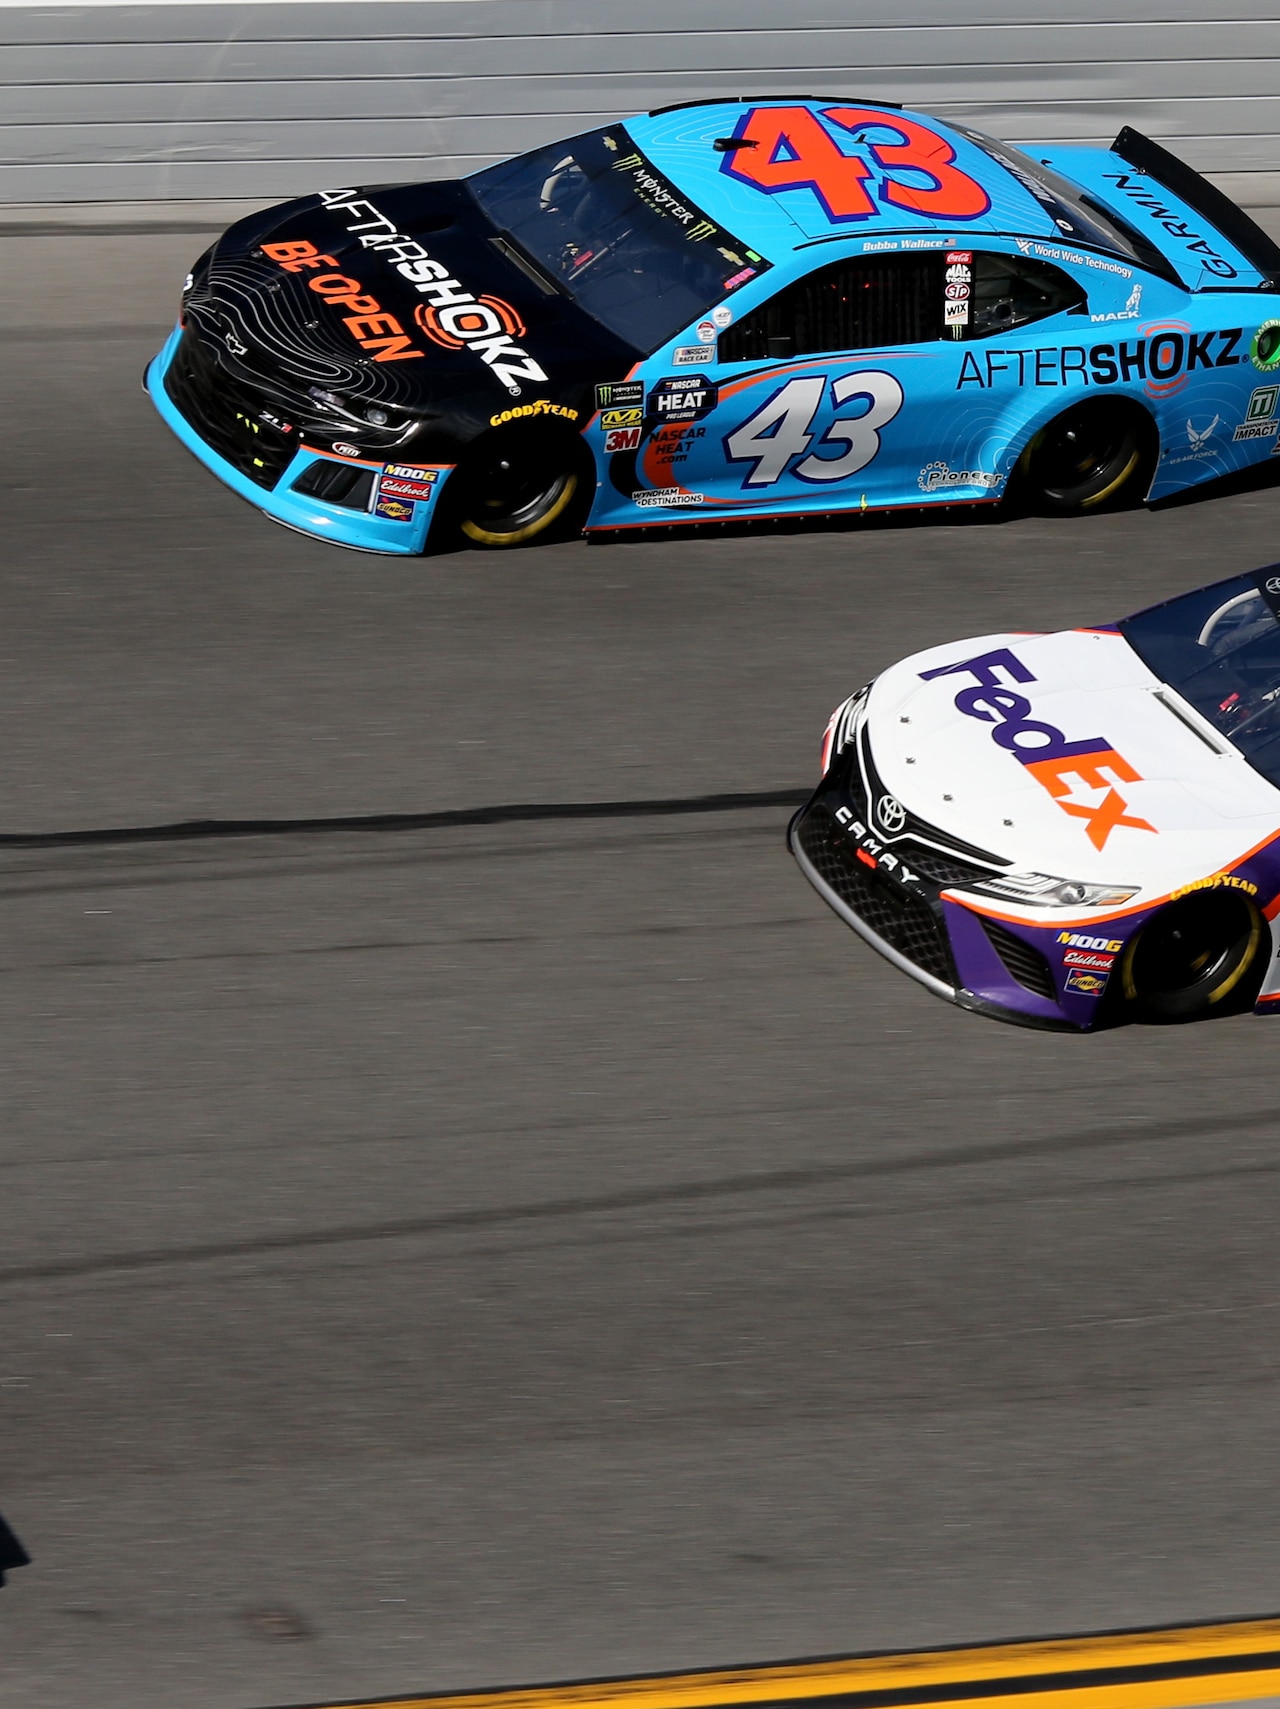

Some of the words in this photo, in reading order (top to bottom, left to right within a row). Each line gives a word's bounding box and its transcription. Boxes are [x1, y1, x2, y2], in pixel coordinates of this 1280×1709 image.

[721, 105, 991, 224] 43
[1101, 174, 1238, 279] GARMIN
[862, 242, 898, 252] Bubba
[900, 239, 943, 249] Wallace
[1034, 244, 1061, 260] World
[1062, 251, 1083, 265] Wide
[1084, 257, 1133, 279] Technology
[948, 284, 967, 298] STP
[260, 240, 339, 273] BE
[308, 273, 424, 363] OPEN
[946, 303, 966, 317] WIX
[1091, 311, 1139, 322] MACK
[956, 328, 1244, 390] AFTERSHOKZ
[671, 379, 701, 390] NASCAR
[658, 391, 706, 411] HEAT
[649, 427, 706, 443] NASCAR
[725, 369, 903, 490] 43
[1235, 426, 1276, 440] IMPACT
[606, 429, 641, 451] 3M
[656, 441, 695, 455] HEAT
[656, 454, 688, 465] .com
[384, 464, 438, 482] MOOG
[380, 480, 430, 498] Edelbrock
[633, 488, 677, 499] WYNDHAM
[641, 495, 702, 506] DESTINATIONS
[377, 503, 413, 516] SUNOCO
[917, 648, 1159, 852] FedEx
[835, 806, 920, 884] CAMRY
[1056, 931, 1124, 952] MOOG
[1064, 952, 1114, 968] Edelbrock
[1068, 977, 1106, 989] SUNOCO
